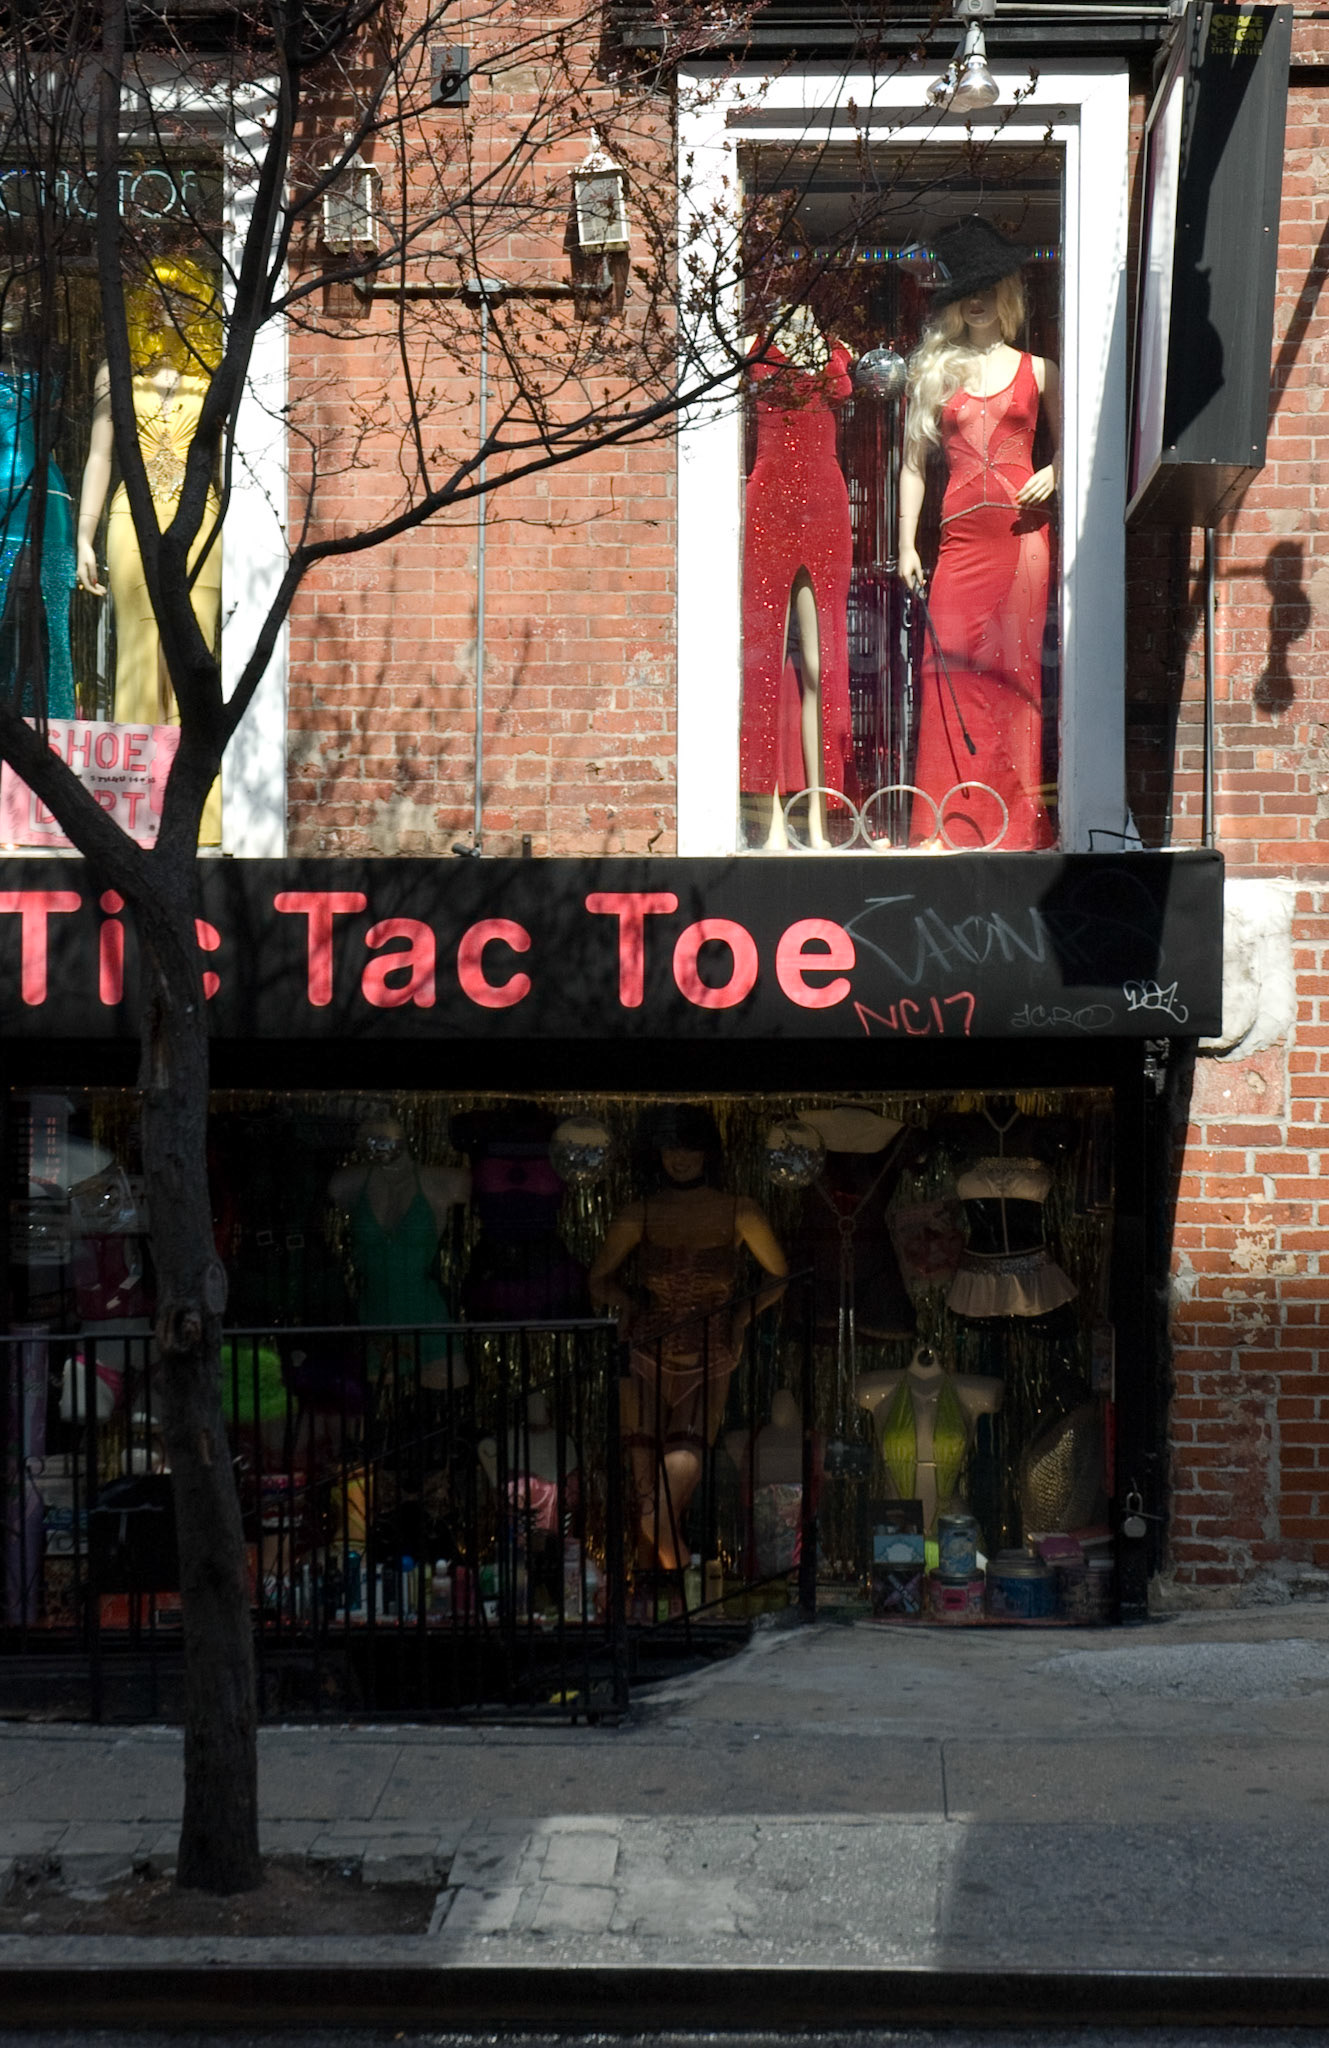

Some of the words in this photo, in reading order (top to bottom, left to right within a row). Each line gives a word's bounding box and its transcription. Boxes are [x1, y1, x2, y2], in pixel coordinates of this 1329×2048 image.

[46, 729, 149, 772] SHOE
[272, 890, 532, 1010] Tac
[585, 891, 857, 1010] Toe
